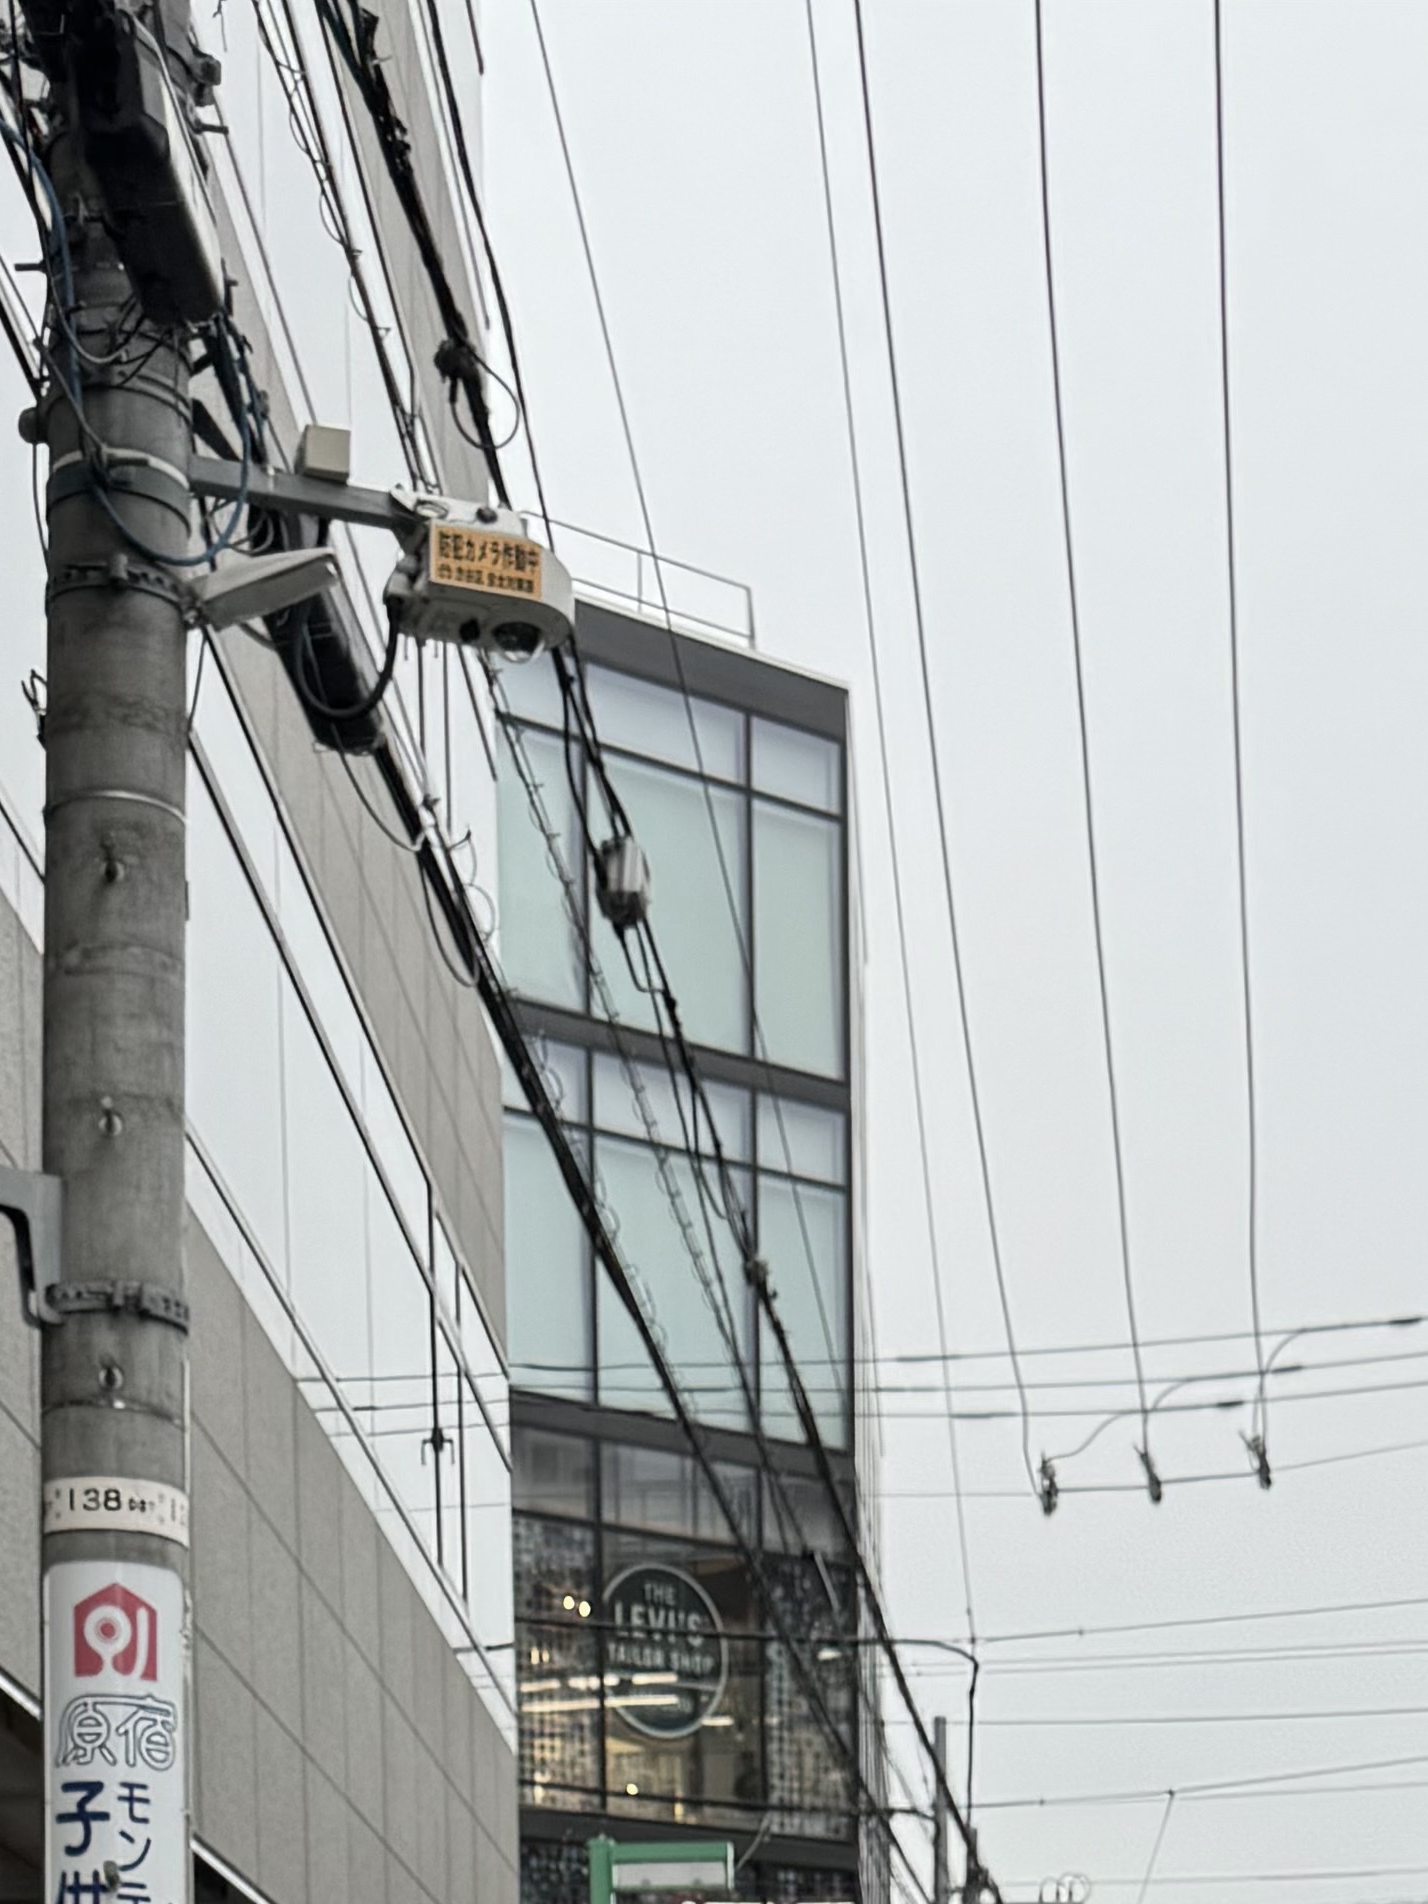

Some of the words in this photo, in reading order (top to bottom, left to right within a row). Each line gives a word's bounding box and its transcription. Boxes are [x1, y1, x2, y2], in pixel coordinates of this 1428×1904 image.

[69, 1488, 122, 1512] 138
[644, 1583, 676, 1605] THE
[671, 1651, 714, 1674] SHOP
